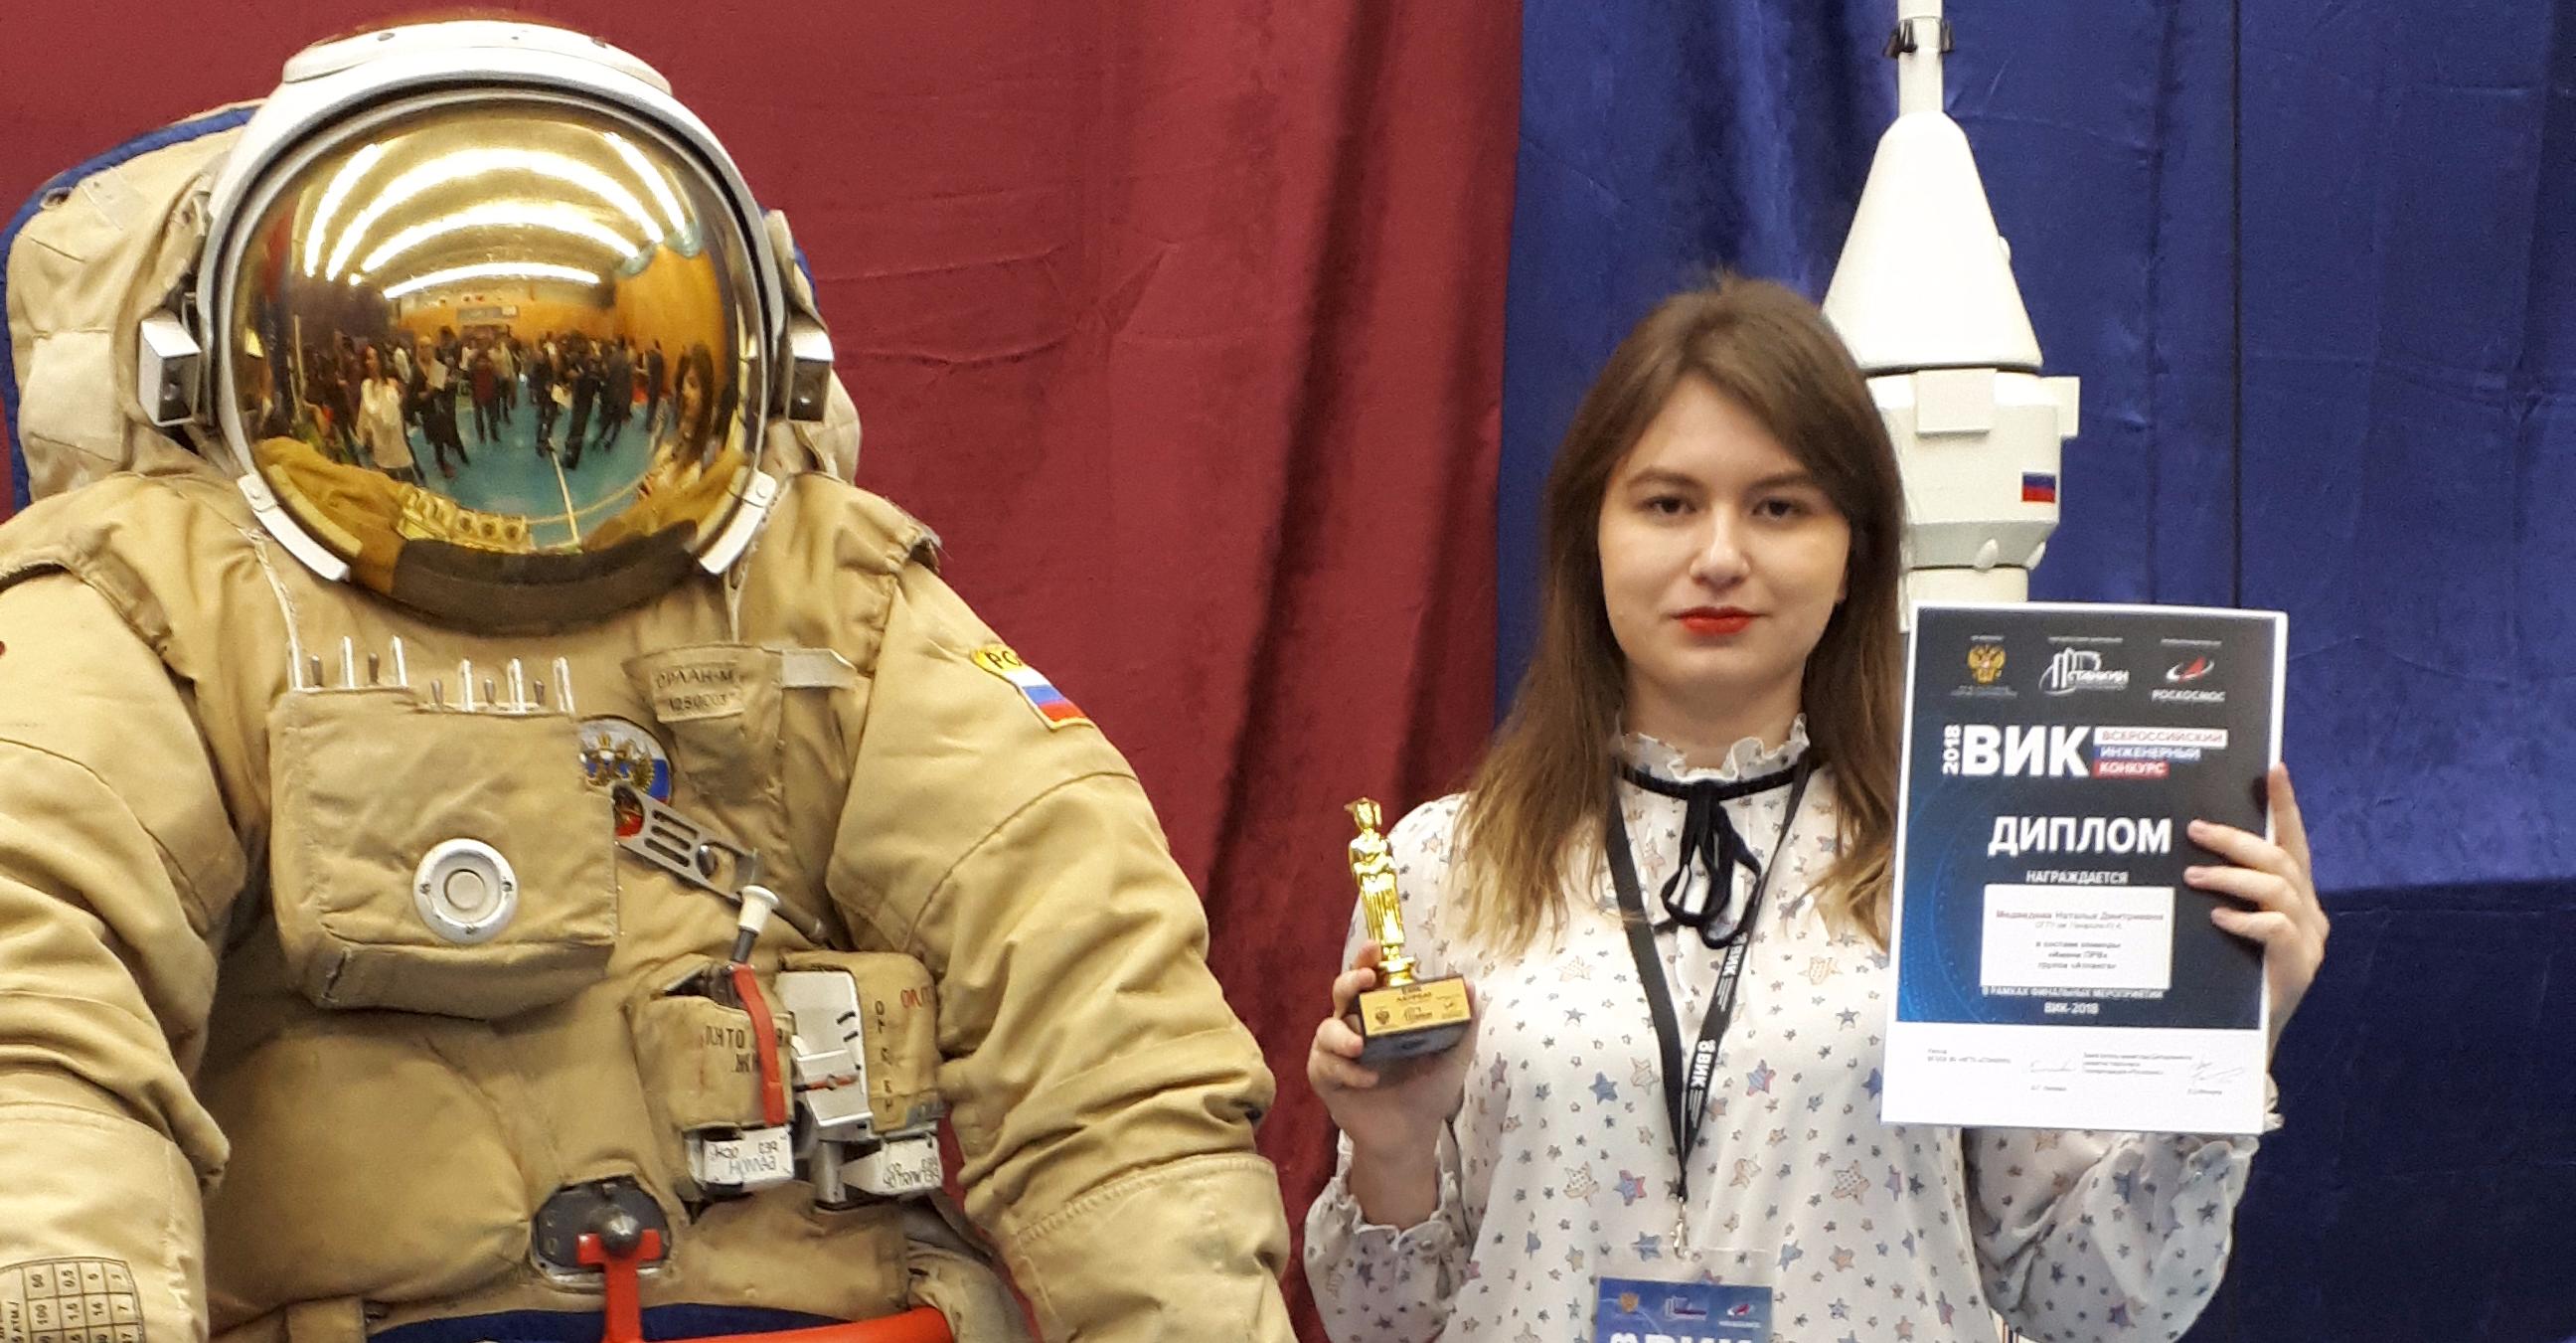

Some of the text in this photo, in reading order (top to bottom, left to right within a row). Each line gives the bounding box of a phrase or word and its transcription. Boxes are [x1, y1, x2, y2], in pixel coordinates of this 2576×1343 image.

[2152, 689, 2226, 703] РОСКОСМОС
[2100, 729, 2224, 744] ВСЕРОССИЙСКИЙ
[1942, 724, 1961, 775] 2018
[1962, 725, 2091, 777] ВИК
[2099, 746, 2201, 760] ИНЖЕНЕРНЫЙ
[2098, 761, 2168, 776] КОНКУРС
[1988, 816, 2174, 858] ДИПЛОМ
[2025, 870, 2130, 886] НАГРАЖДАЕТСЯ
[2043, 1001, 2100, 1015] ВИК-2018
[1690, 1052, 1712, 1089] ВИК
